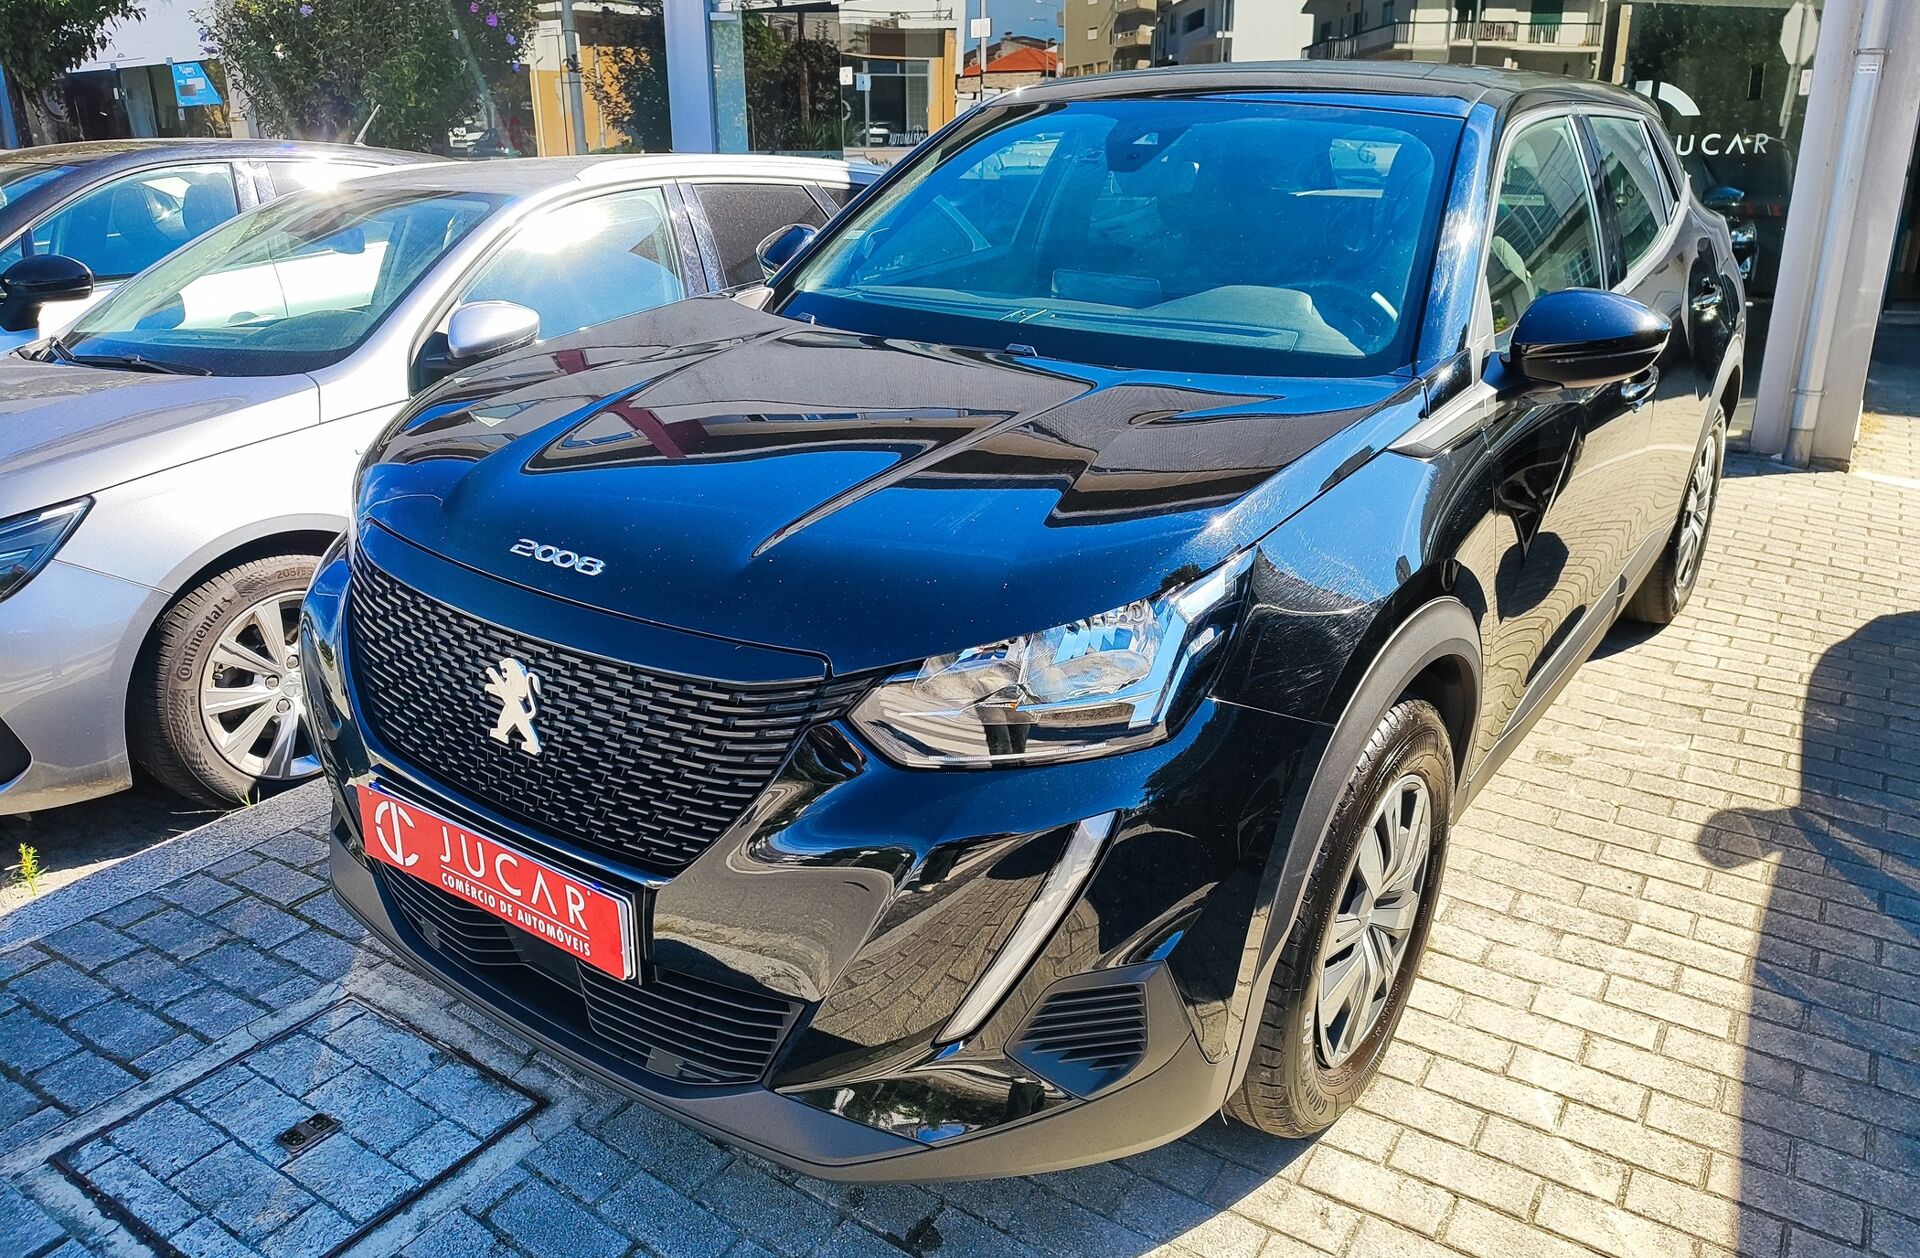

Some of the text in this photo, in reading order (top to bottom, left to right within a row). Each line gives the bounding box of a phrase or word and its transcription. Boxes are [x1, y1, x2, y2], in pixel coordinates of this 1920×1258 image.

[1675, 132, 1770, 156] UCAR
[509, 538, 606, 576] 2008
[176, 603, 226, 682] Continental
[440, 825, 589, 931] JUCAR
[441, 872, 592, 957] COMÉRCIO DE AUTOMÓVEIS
